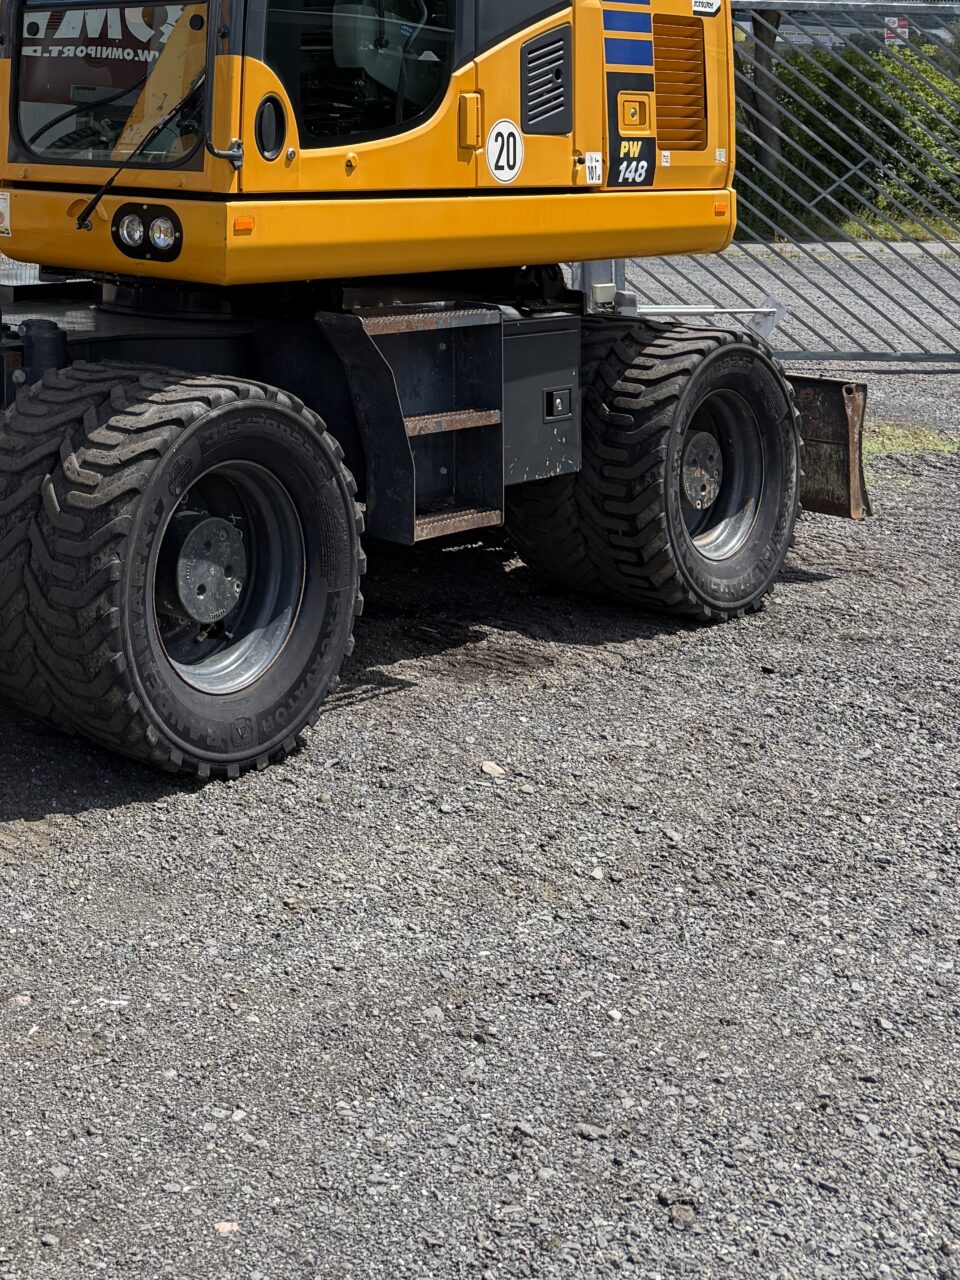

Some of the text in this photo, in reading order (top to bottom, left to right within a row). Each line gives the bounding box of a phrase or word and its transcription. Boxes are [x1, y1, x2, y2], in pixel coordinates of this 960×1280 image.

[494, 131, 517, 171] 20
[620, 141, 642, 158] PW
[618, 160, 648, 183] 148
